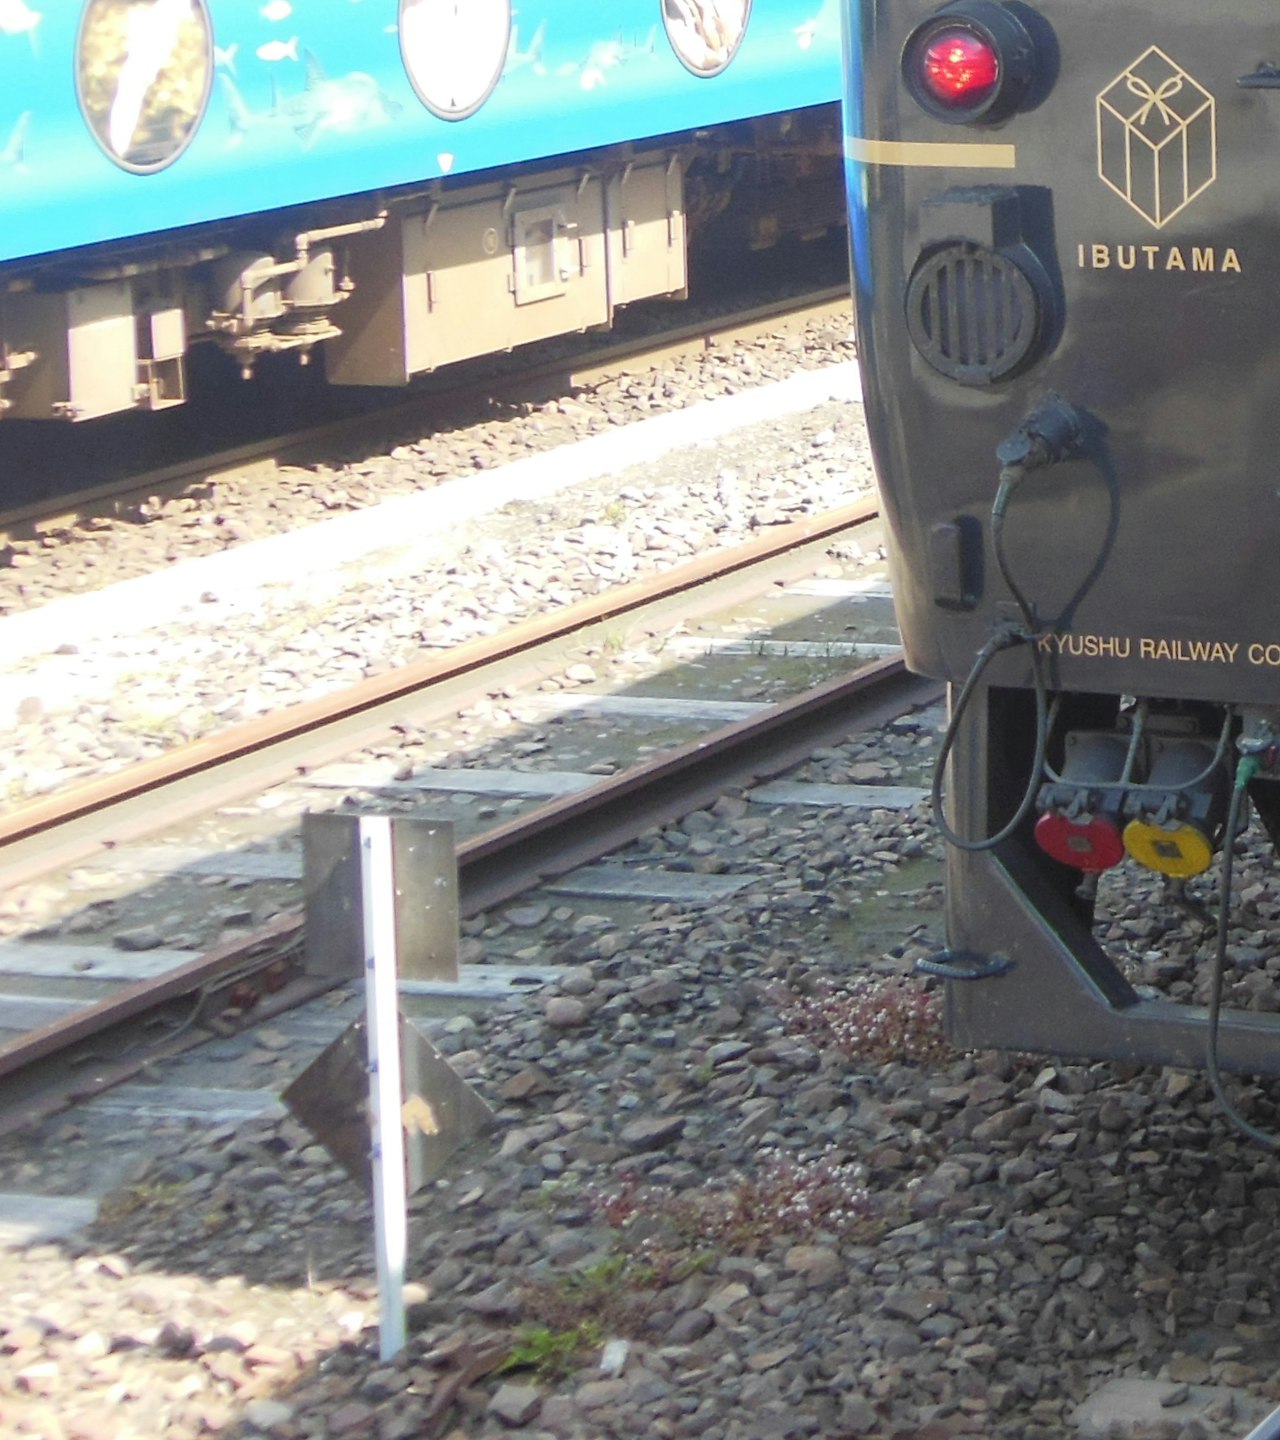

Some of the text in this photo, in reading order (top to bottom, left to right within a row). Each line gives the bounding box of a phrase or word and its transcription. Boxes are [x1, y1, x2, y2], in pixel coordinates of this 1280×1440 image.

[1078, 244, 1241, 273] IBUTAMA
[1038, 633, 1130, 658] KYUSHU
[1139, 638, 1239, 665] RAILWAY
